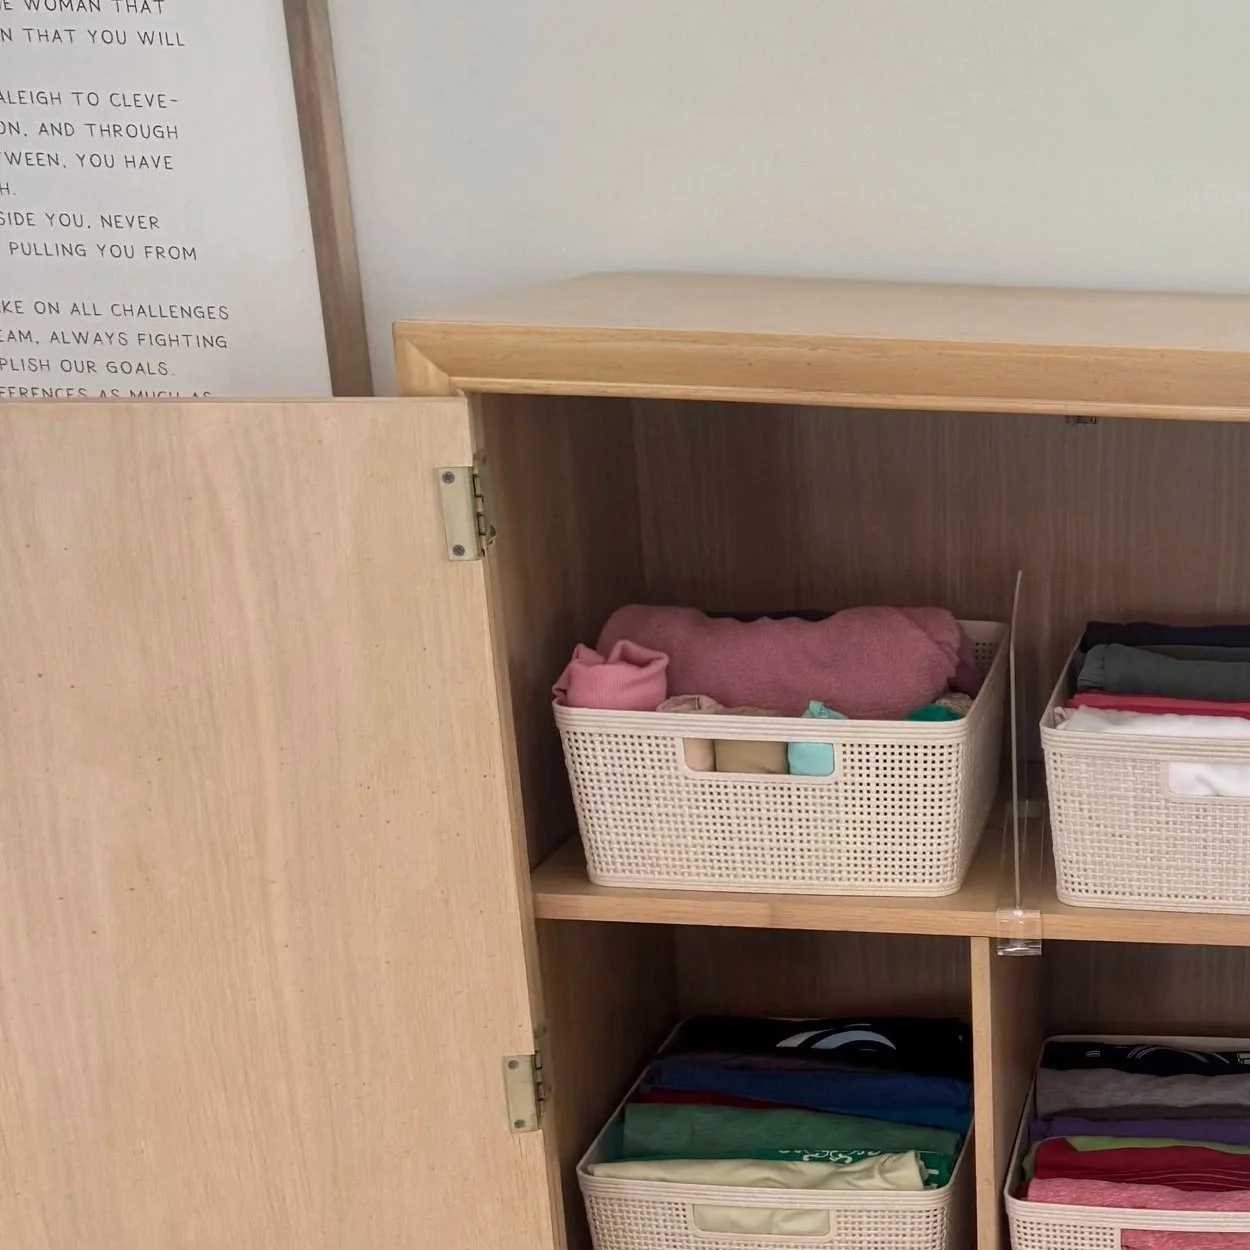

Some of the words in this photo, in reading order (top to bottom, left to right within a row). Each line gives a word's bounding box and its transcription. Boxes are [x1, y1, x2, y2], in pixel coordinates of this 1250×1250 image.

[110, 0, 165, 15] THAT
[21, 27, 77, 44] THAT
[86, 29, 127, 46] YOU
[136, 30, 185, 47] WILL
[70, 91, 100, 107] TO
[38, 122, 75, 137] AND
[83, 122, 179, 140] THROUGH
[0, 151, 67, 169] WEEN,
[75, 152, 115, 169] YOU
[124, 154, 174, 171] HAVE
[99, 214, 160, 230] NEVER
[8, 241, 87, 258] PULLING
[95, 243, 135, 260] YOU
[144, 245, 197, 261] FROM
[0, 299, 25, 315] KE
[33, 300, 60, 316] ON
[69, 301, 103, 317] ALL
[110, 303, 229, 321] CHALLENGES
[49, 330, 129, 347] ALWAYS
[137, 332, 228, 349] FIGHTING
[59, 358, 98, 374] OUR
